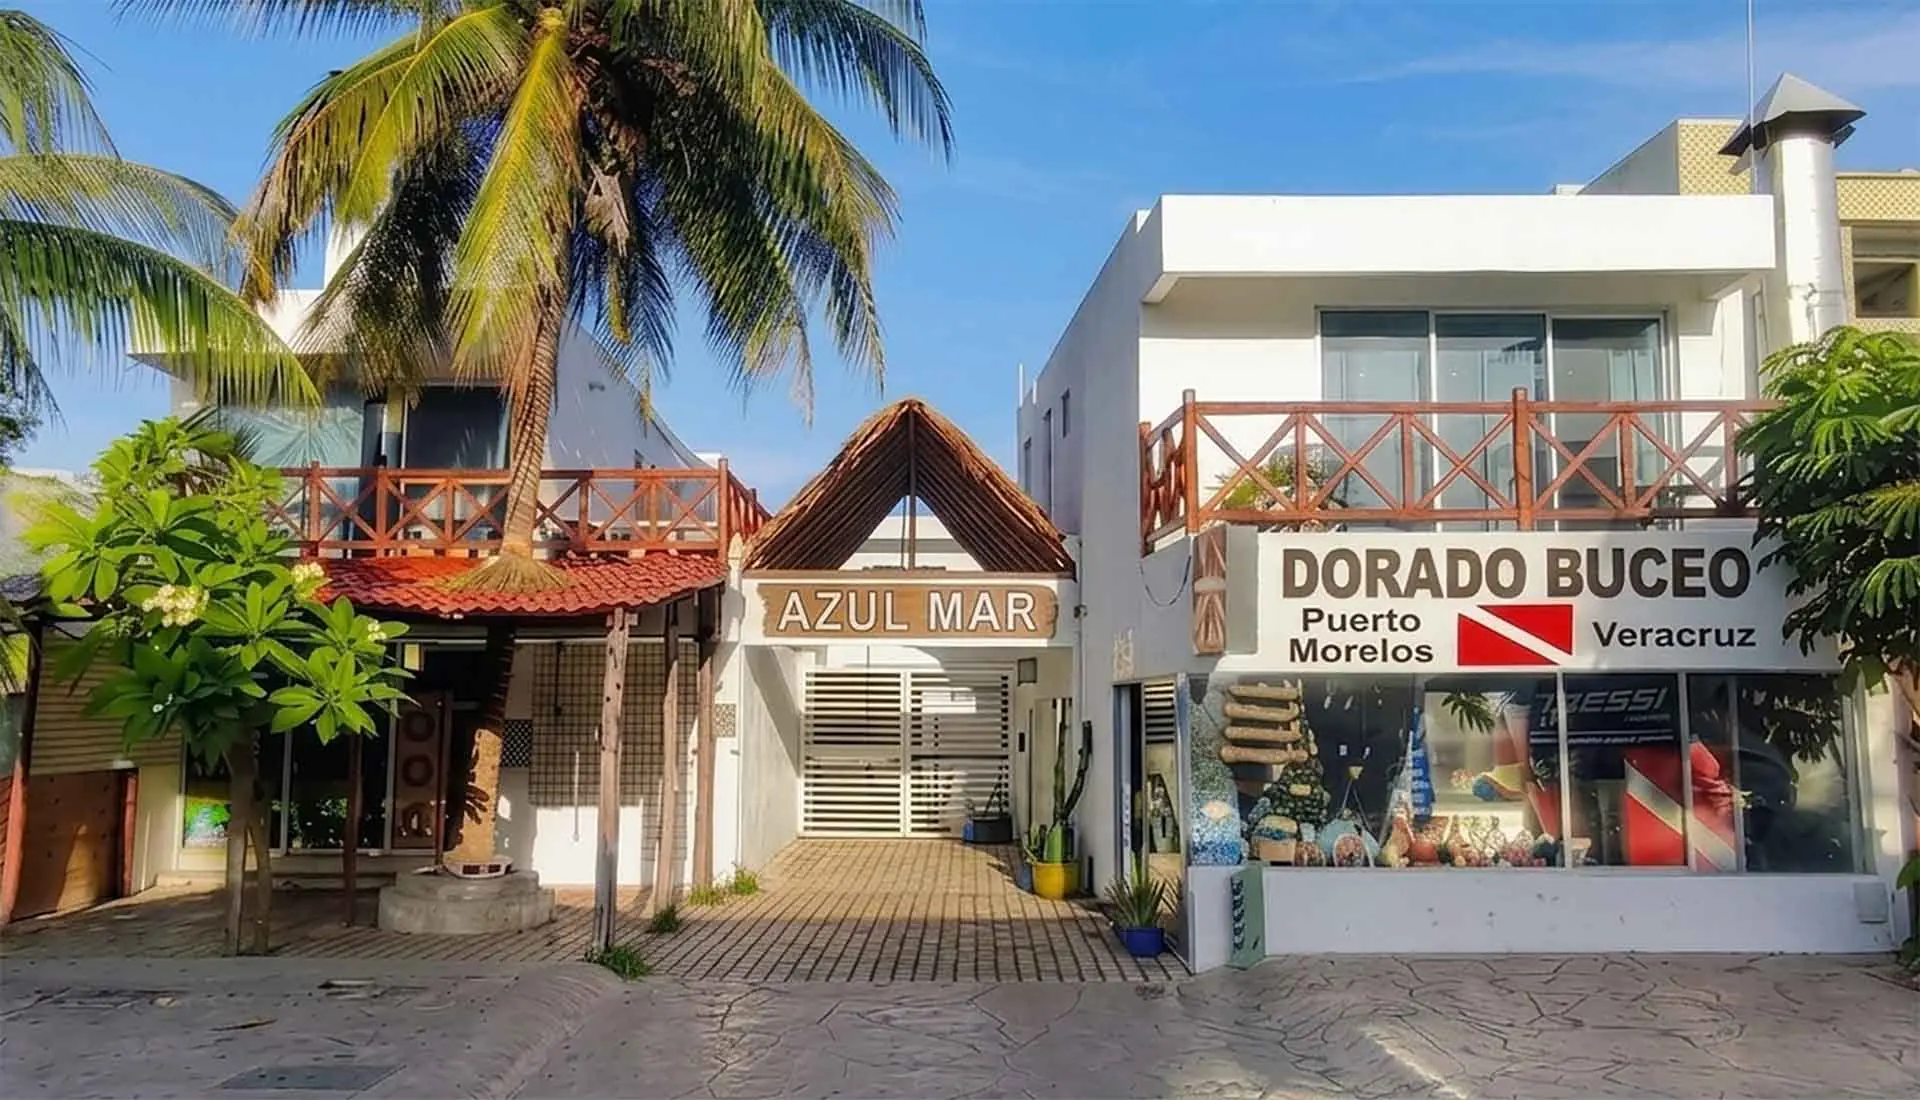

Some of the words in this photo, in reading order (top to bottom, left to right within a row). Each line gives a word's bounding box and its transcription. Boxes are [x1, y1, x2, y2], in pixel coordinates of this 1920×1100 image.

[1282, 547, 1527, 599] DORADO
[1546, 547, 1750, 599] BUCEO
[776, 590, 909, 631] AZUL
[927, 590, 1037, 631] MAR
[1302, 607, 1421, 633] Puerto
[1592, 621, 1757, 648] Veracruz
[1290, 638, 1434, 663] Morelos
